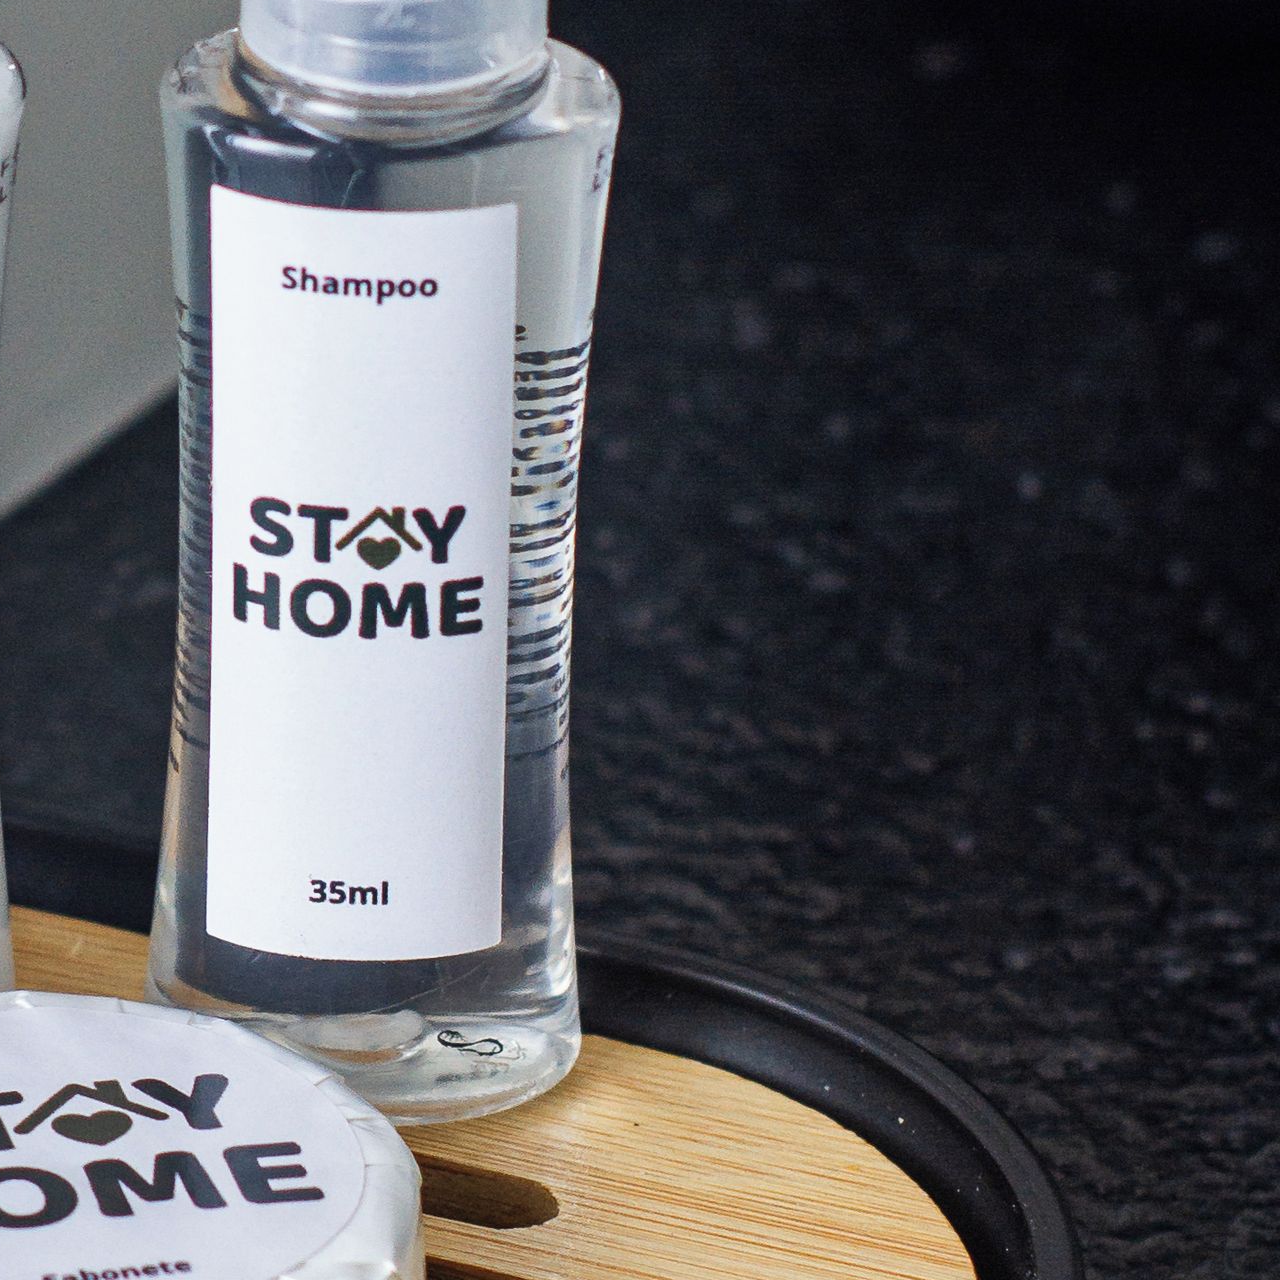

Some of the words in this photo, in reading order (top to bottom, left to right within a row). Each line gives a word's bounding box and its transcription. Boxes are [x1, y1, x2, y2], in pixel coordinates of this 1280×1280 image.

[282, 266, 438, 305] Shampoo
[249, 497, 467, 571] STAY
[233, 562, 485, 640] HOME
[309, 879, 389, 906] 35ml
